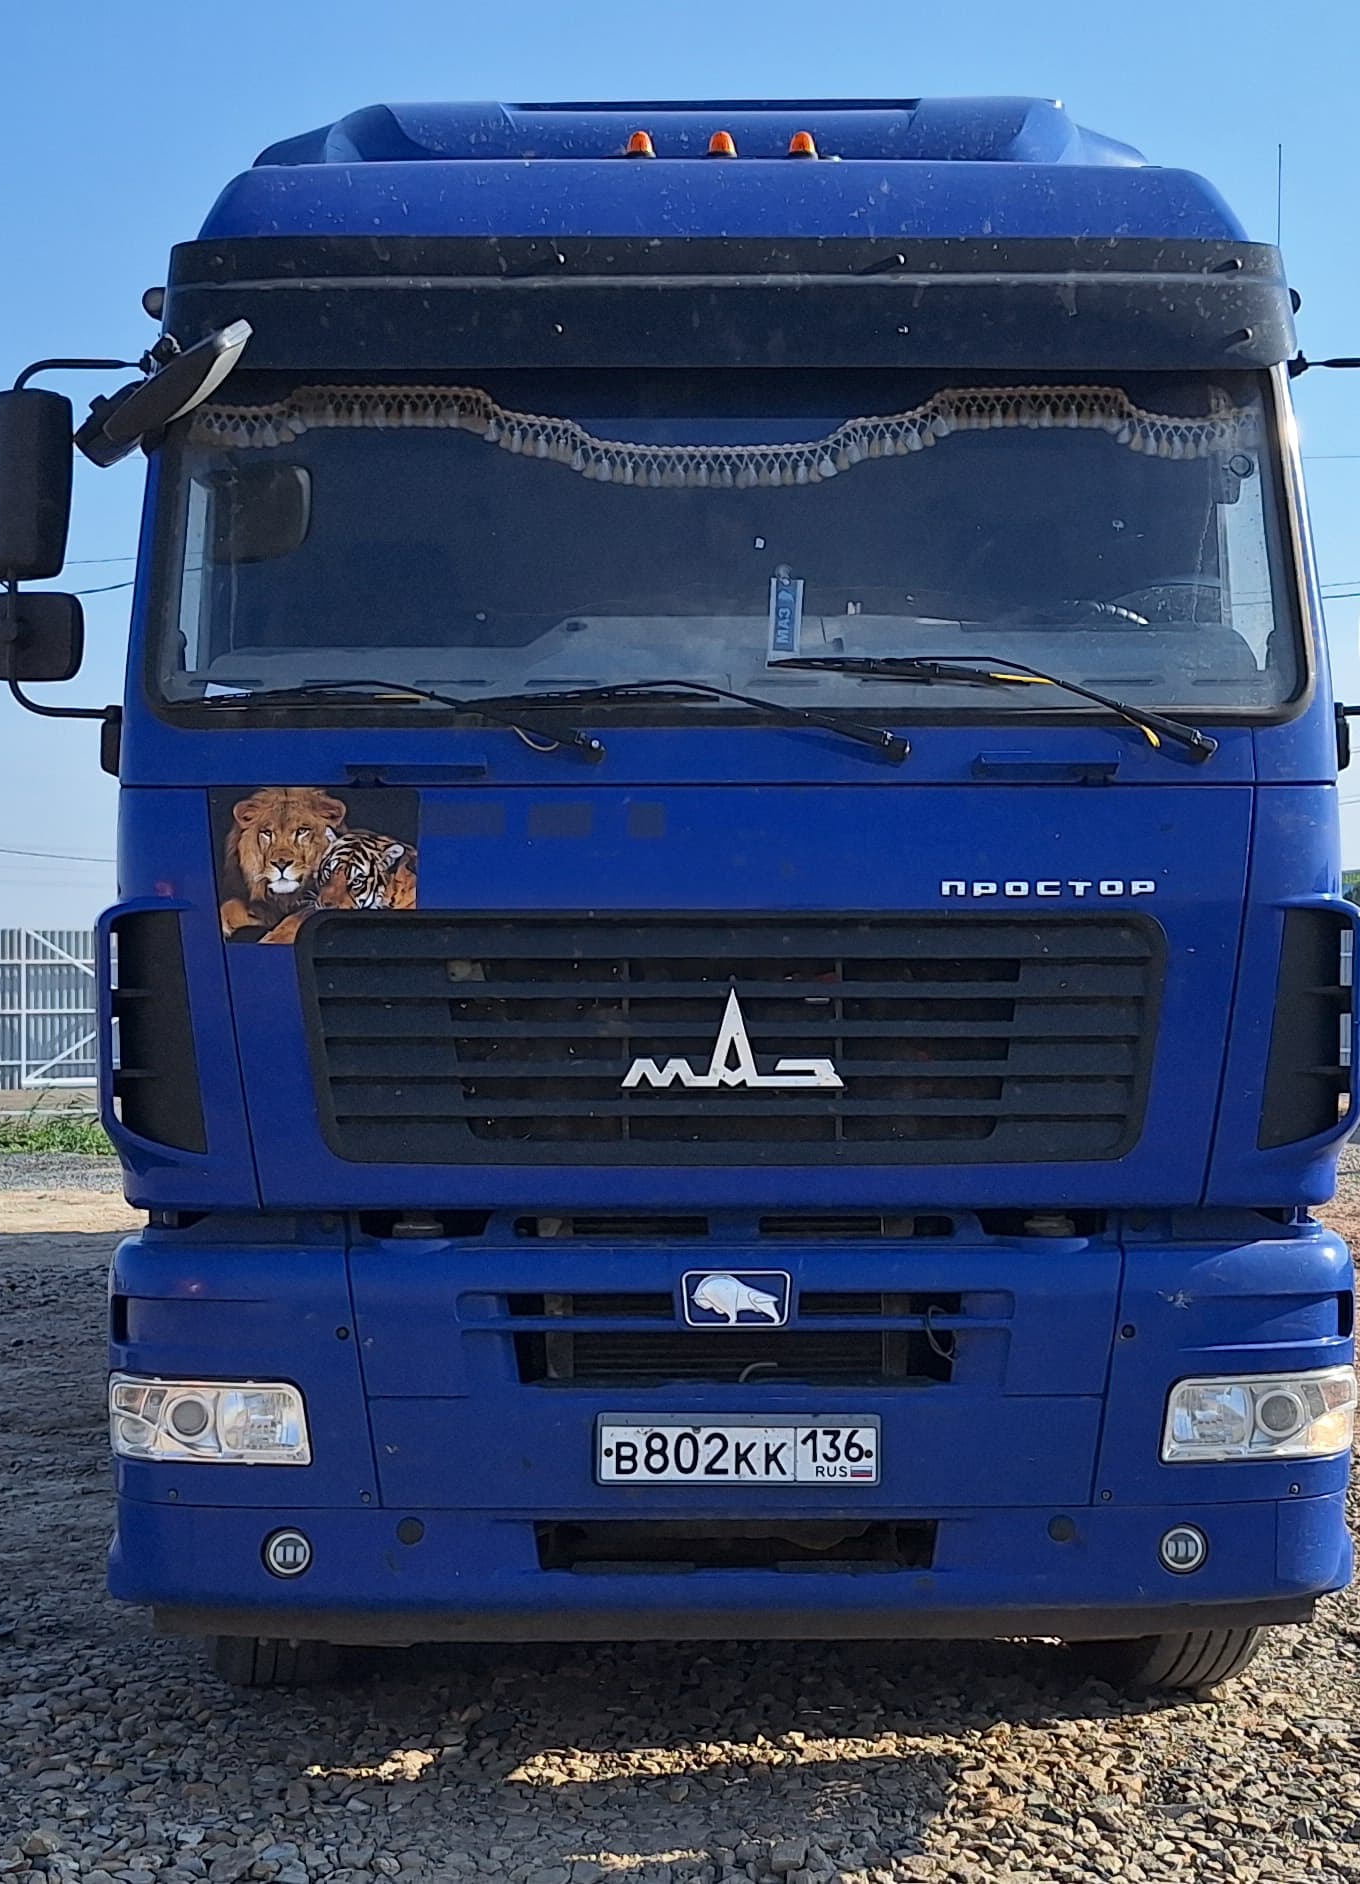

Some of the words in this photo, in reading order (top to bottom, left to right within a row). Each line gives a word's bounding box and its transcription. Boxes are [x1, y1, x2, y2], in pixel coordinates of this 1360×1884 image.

[776, 607, 791, 644] МАЗ
[941, 880, 1156, 897] ПРОСТОР
[620, 985, 845, 1088] МАЗ
[801, 1429, 865, 1463] 136
[815, 1466, 848, 1478] RUS
